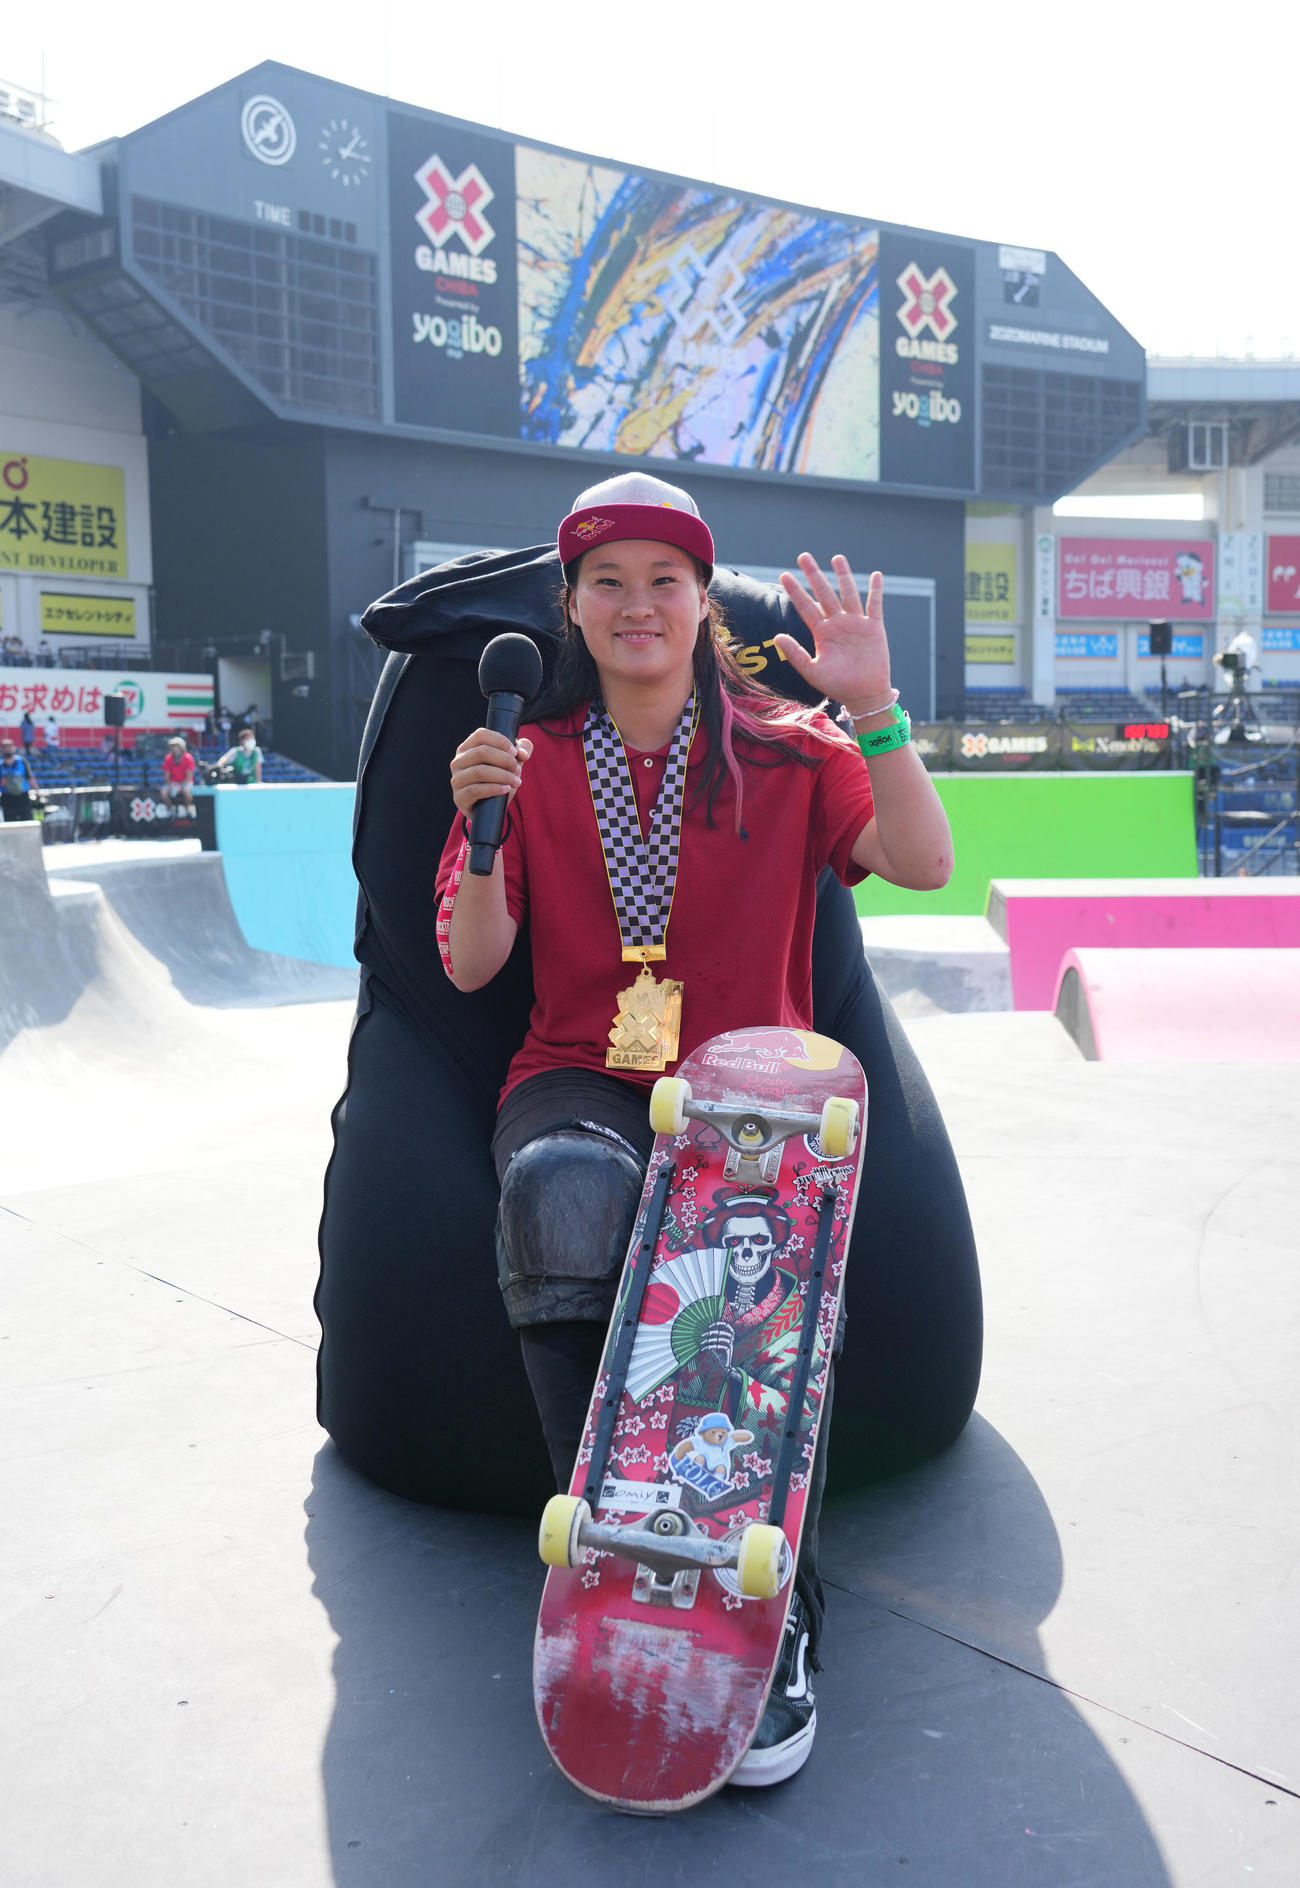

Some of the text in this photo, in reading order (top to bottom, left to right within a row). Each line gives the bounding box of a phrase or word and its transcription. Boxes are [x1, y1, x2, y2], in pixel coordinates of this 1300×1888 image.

[254, 199, 292, 227] TIME
[414, 244, 498, 284] GAMES
[412, 312, 503, 359] yogibo
[895, 336, 959, 365] GAMES
[892, 390, 962, 427] yogibo
[28, 553, 119, 574] DEVELOPER
[1063, 567, 1171, 601] ちば興銀
[987, 736, 1049, 754] GAMES
[612, 1053, 659, 1066] GAMES
[701, 1053, 781, 1074] Red Bull
